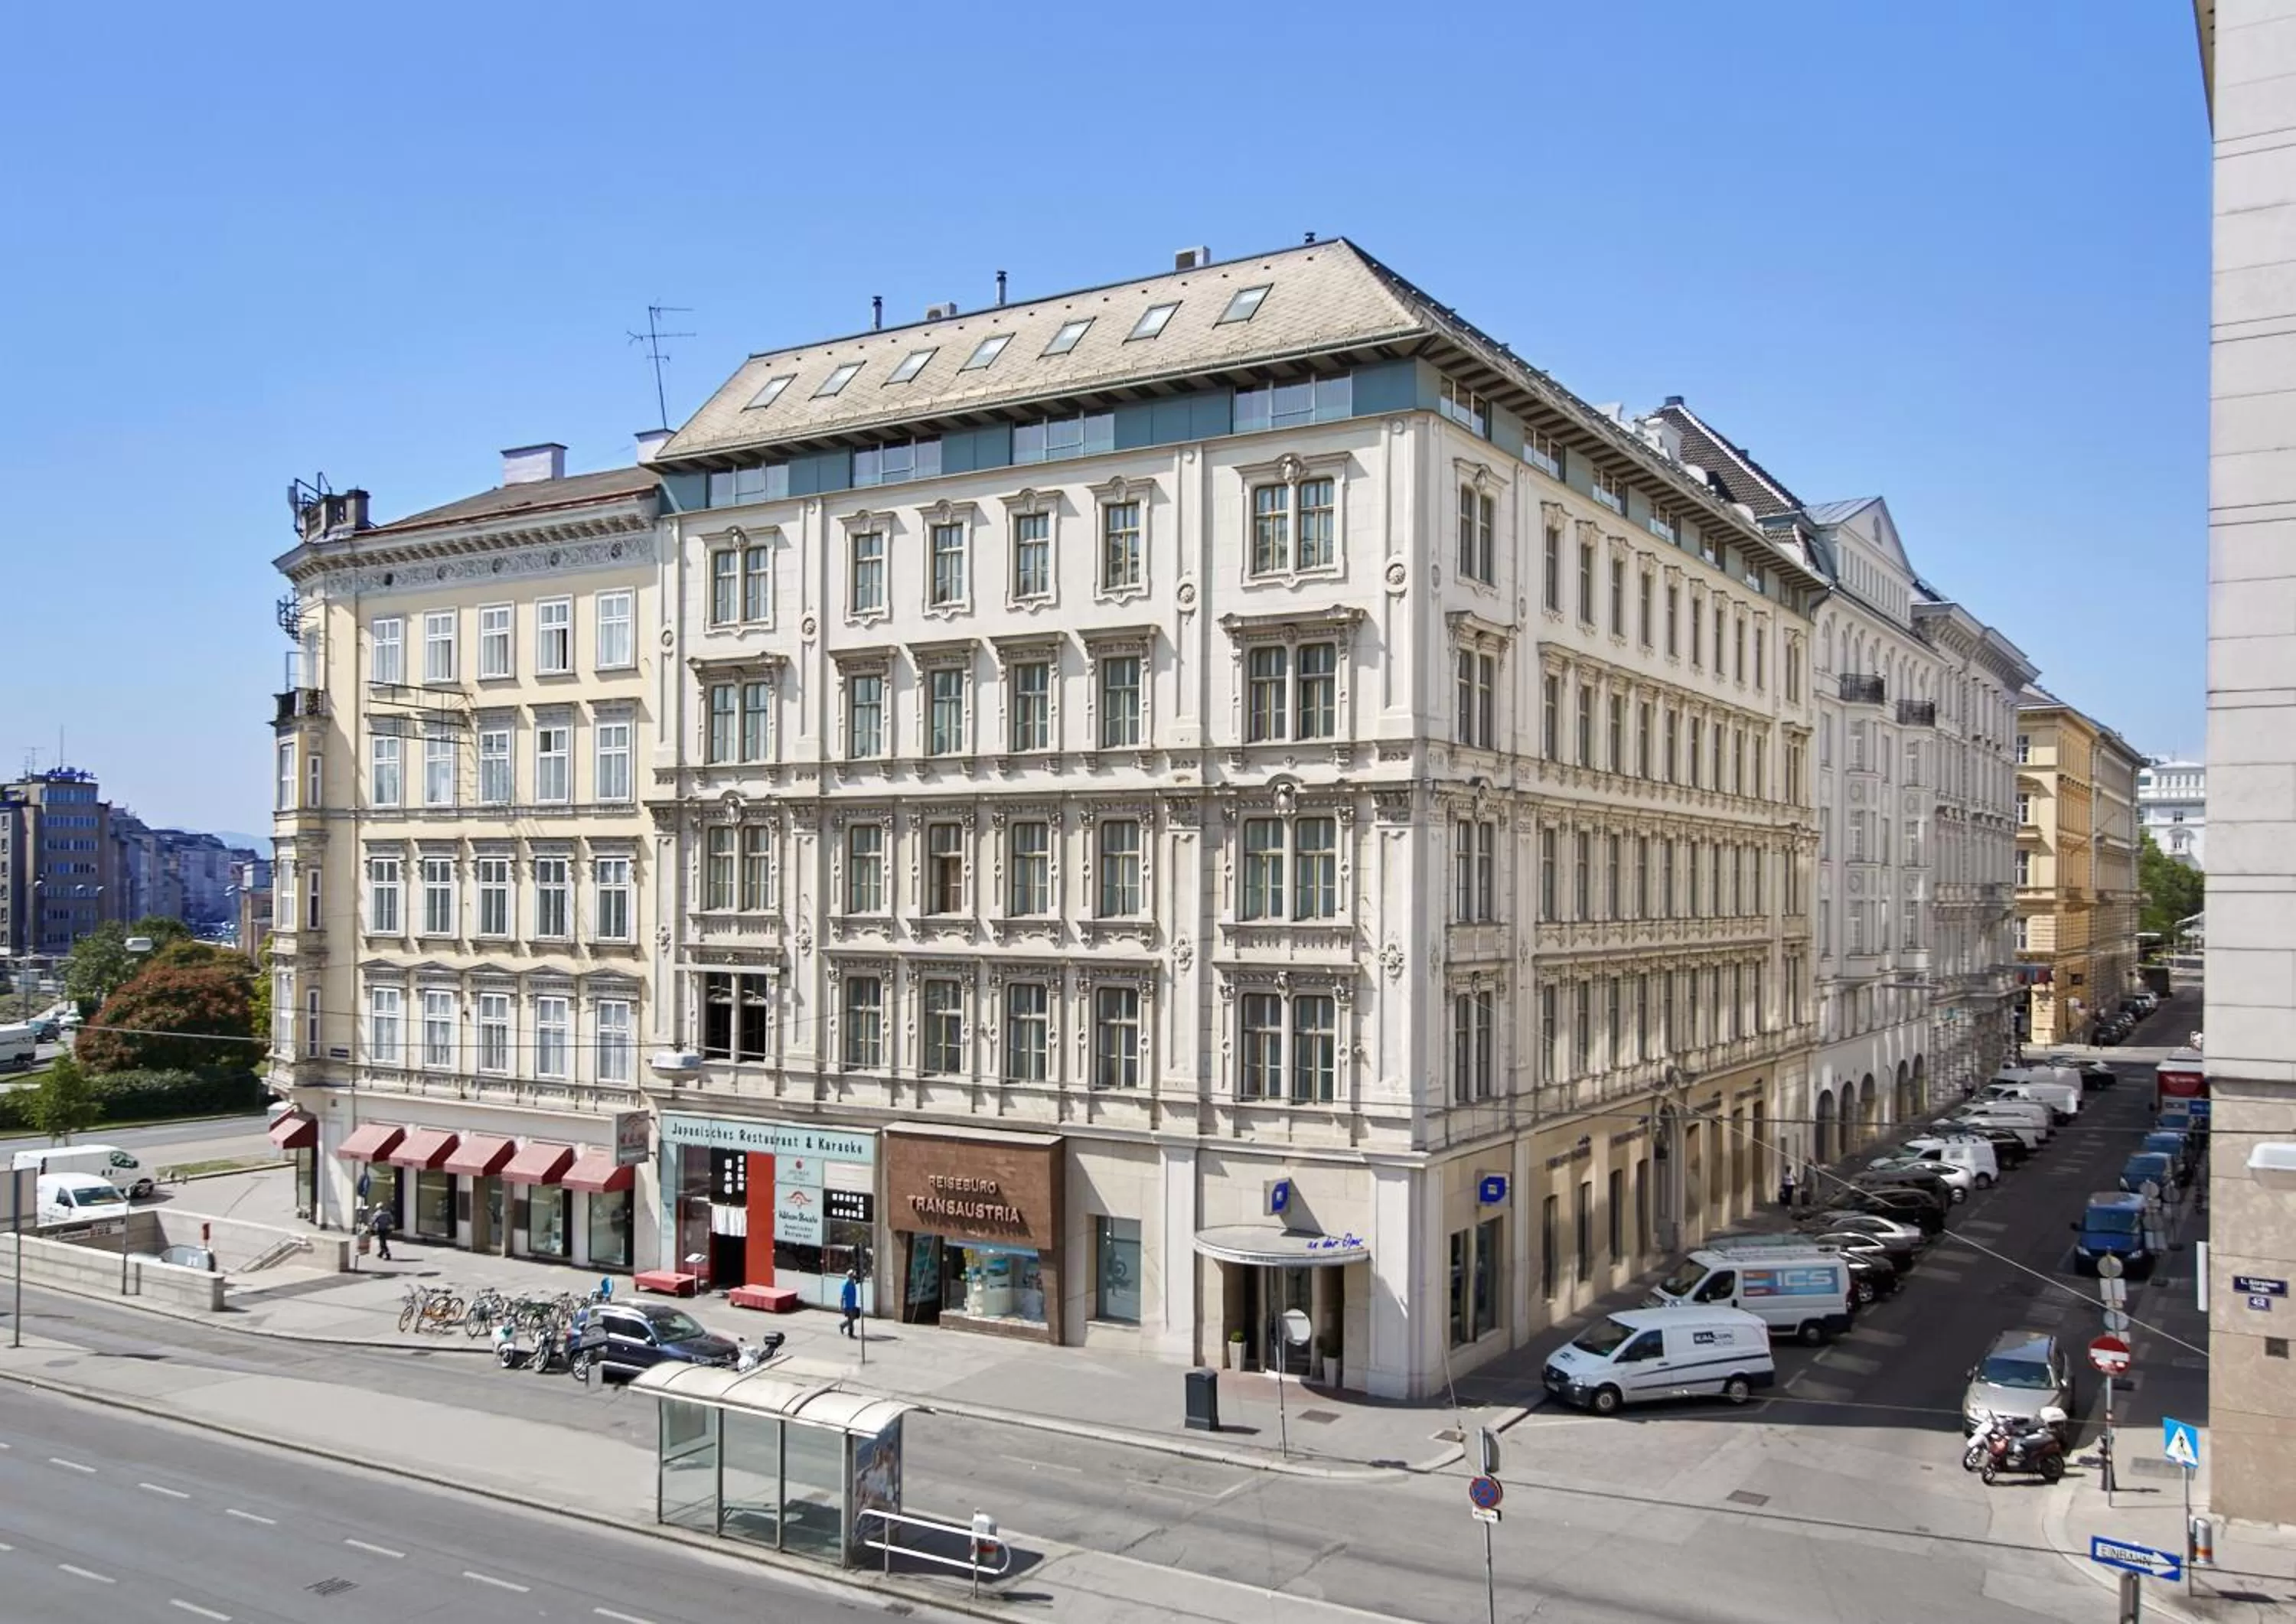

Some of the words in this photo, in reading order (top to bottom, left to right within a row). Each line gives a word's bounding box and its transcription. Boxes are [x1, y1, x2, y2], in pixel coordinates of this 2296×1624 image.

[672, 1122, 733, 1140] Japanisches
[739, 1129, 798, 1147] Restaurant
[806, 1136, 812, 1149] &
[906, 1194, 1020, 1224] TRANSAUSTRIA
